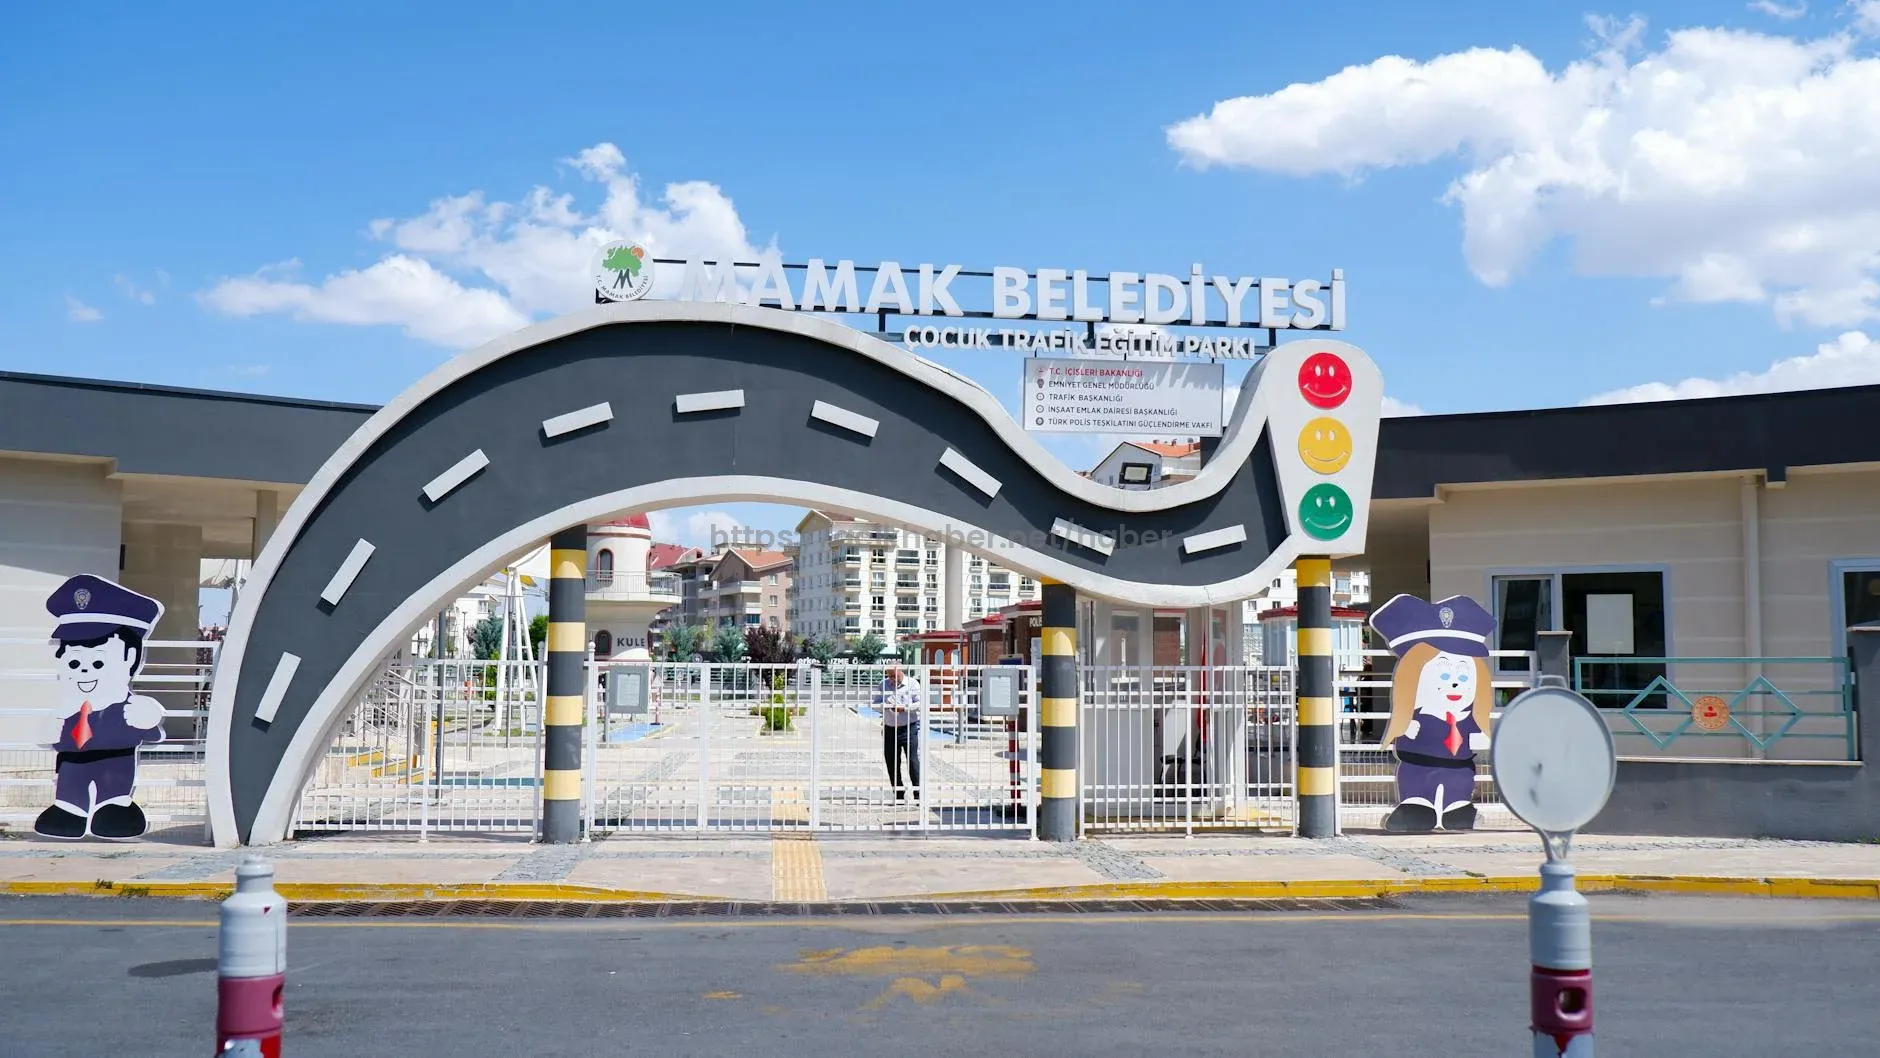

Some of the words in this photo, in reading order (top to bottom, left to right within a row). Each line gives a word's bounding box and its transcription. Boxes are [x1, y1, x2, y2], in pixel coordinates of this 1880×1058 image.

[680, 254, 964, 316] MAMAK
[992, 263, 1346, 330] BELEDİYESİ
[903, 325, 993, 352] ÇOCUK
[998, 329, 1089, 354] TRAFİK
[1095, 328, 1178, 358] EĞİTİM
[1184, 335, 1256, 360] PARKI
[1049, 367, 1063, 376] T.C.
[1082, 381, 1106, 389] GENEL
[1049, 393, 1075, 401] TRAFİK
[1078, 394, 1123, 402] BAŞKANLIĞI
[1076, 406, 1101, 414] EMLAK
[1133, 407, 1178, 416] BAŞKANLIĞI
[1069, 417, 1091, 426] POLİS
[1138, 418, 1190, 428] GÜÇLENDİRME
[1191, 420, 1213, 429] VAKFI
[616, 637, 646, 648] KULE
